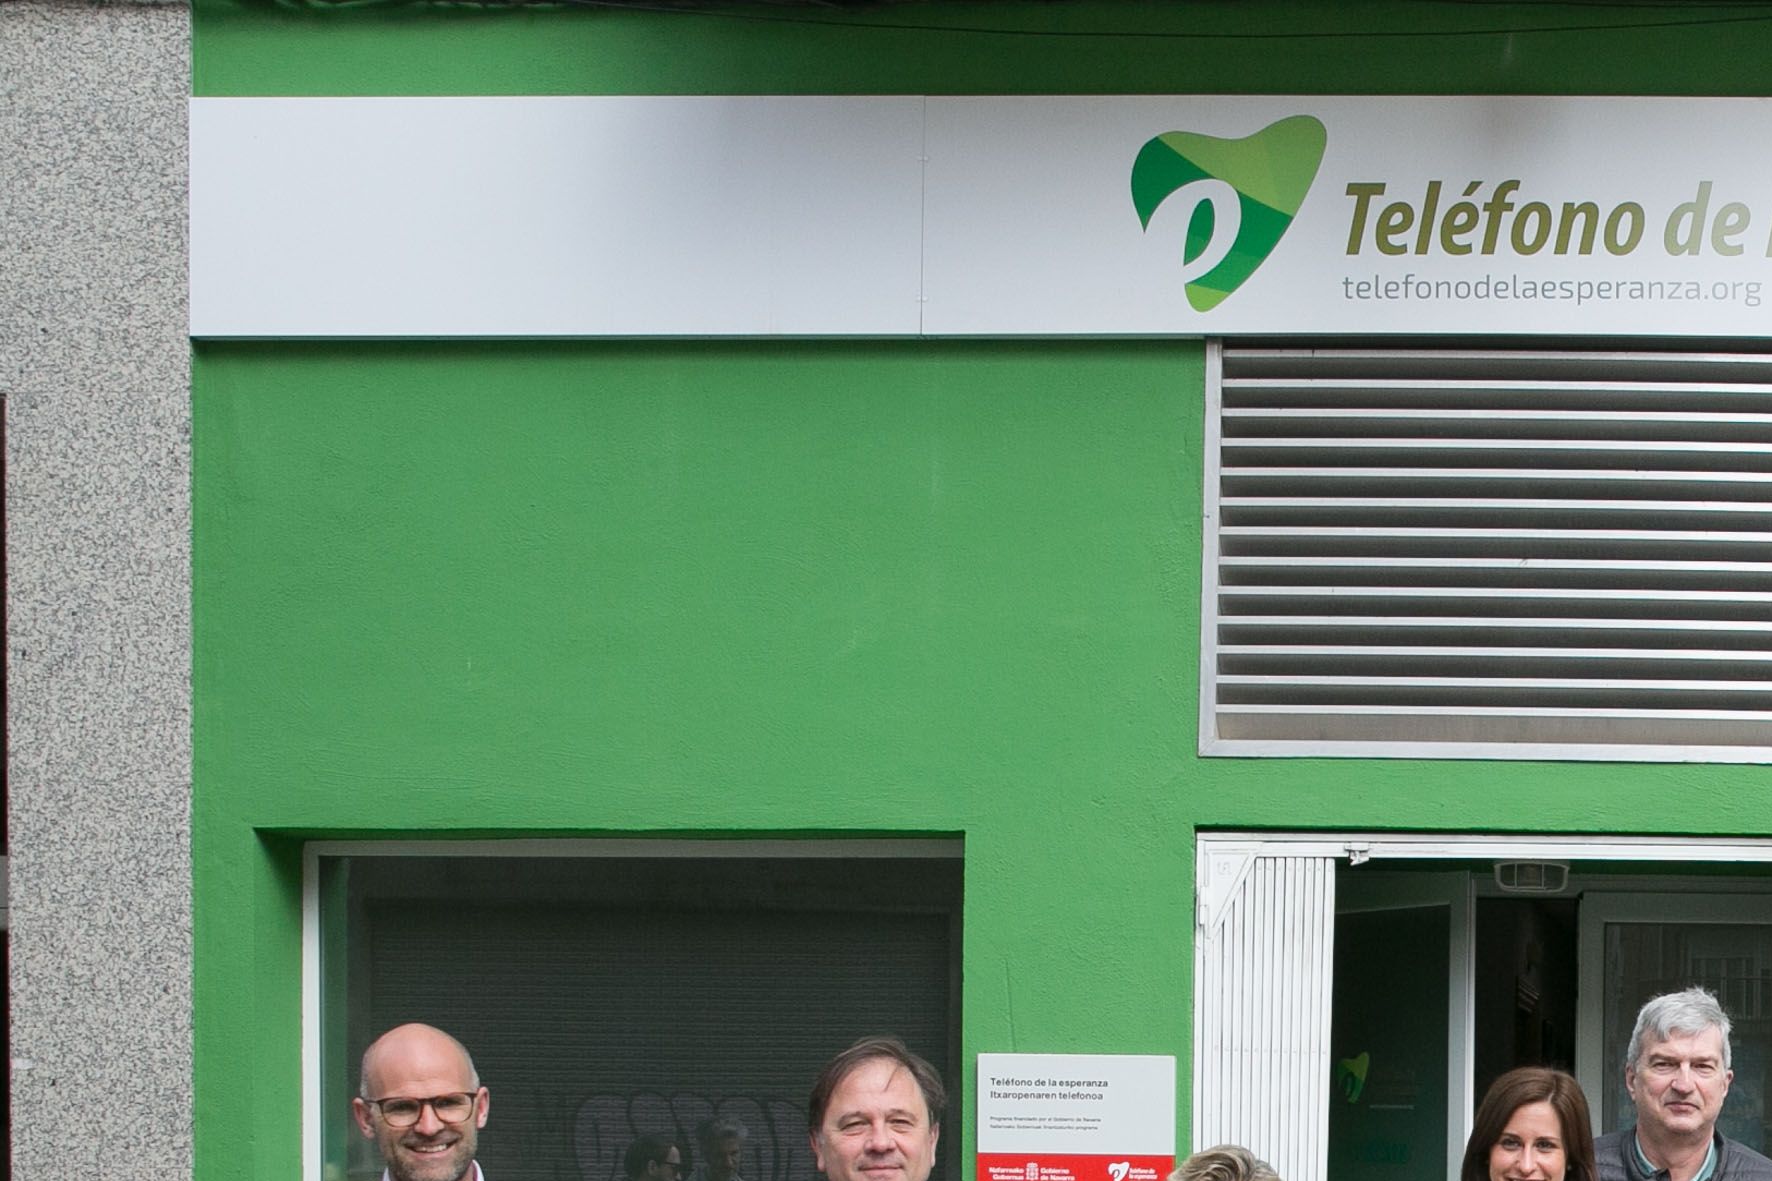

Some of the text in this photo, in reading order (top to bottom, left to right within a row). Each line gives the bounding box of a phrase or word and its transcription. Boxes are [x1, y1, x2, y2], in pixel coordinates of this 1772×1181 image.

[1345, 180, 1645, 256] Teléfono
[1663, 180, 1751, 256] de
[1342, 274, 1762, 306] telefonodelaesperanza.org
[990, 1078, 1108, 1088] Teléfono de la esperanza
[990, 1090, 1103, 1100] Itxaropenaren telefonoa
